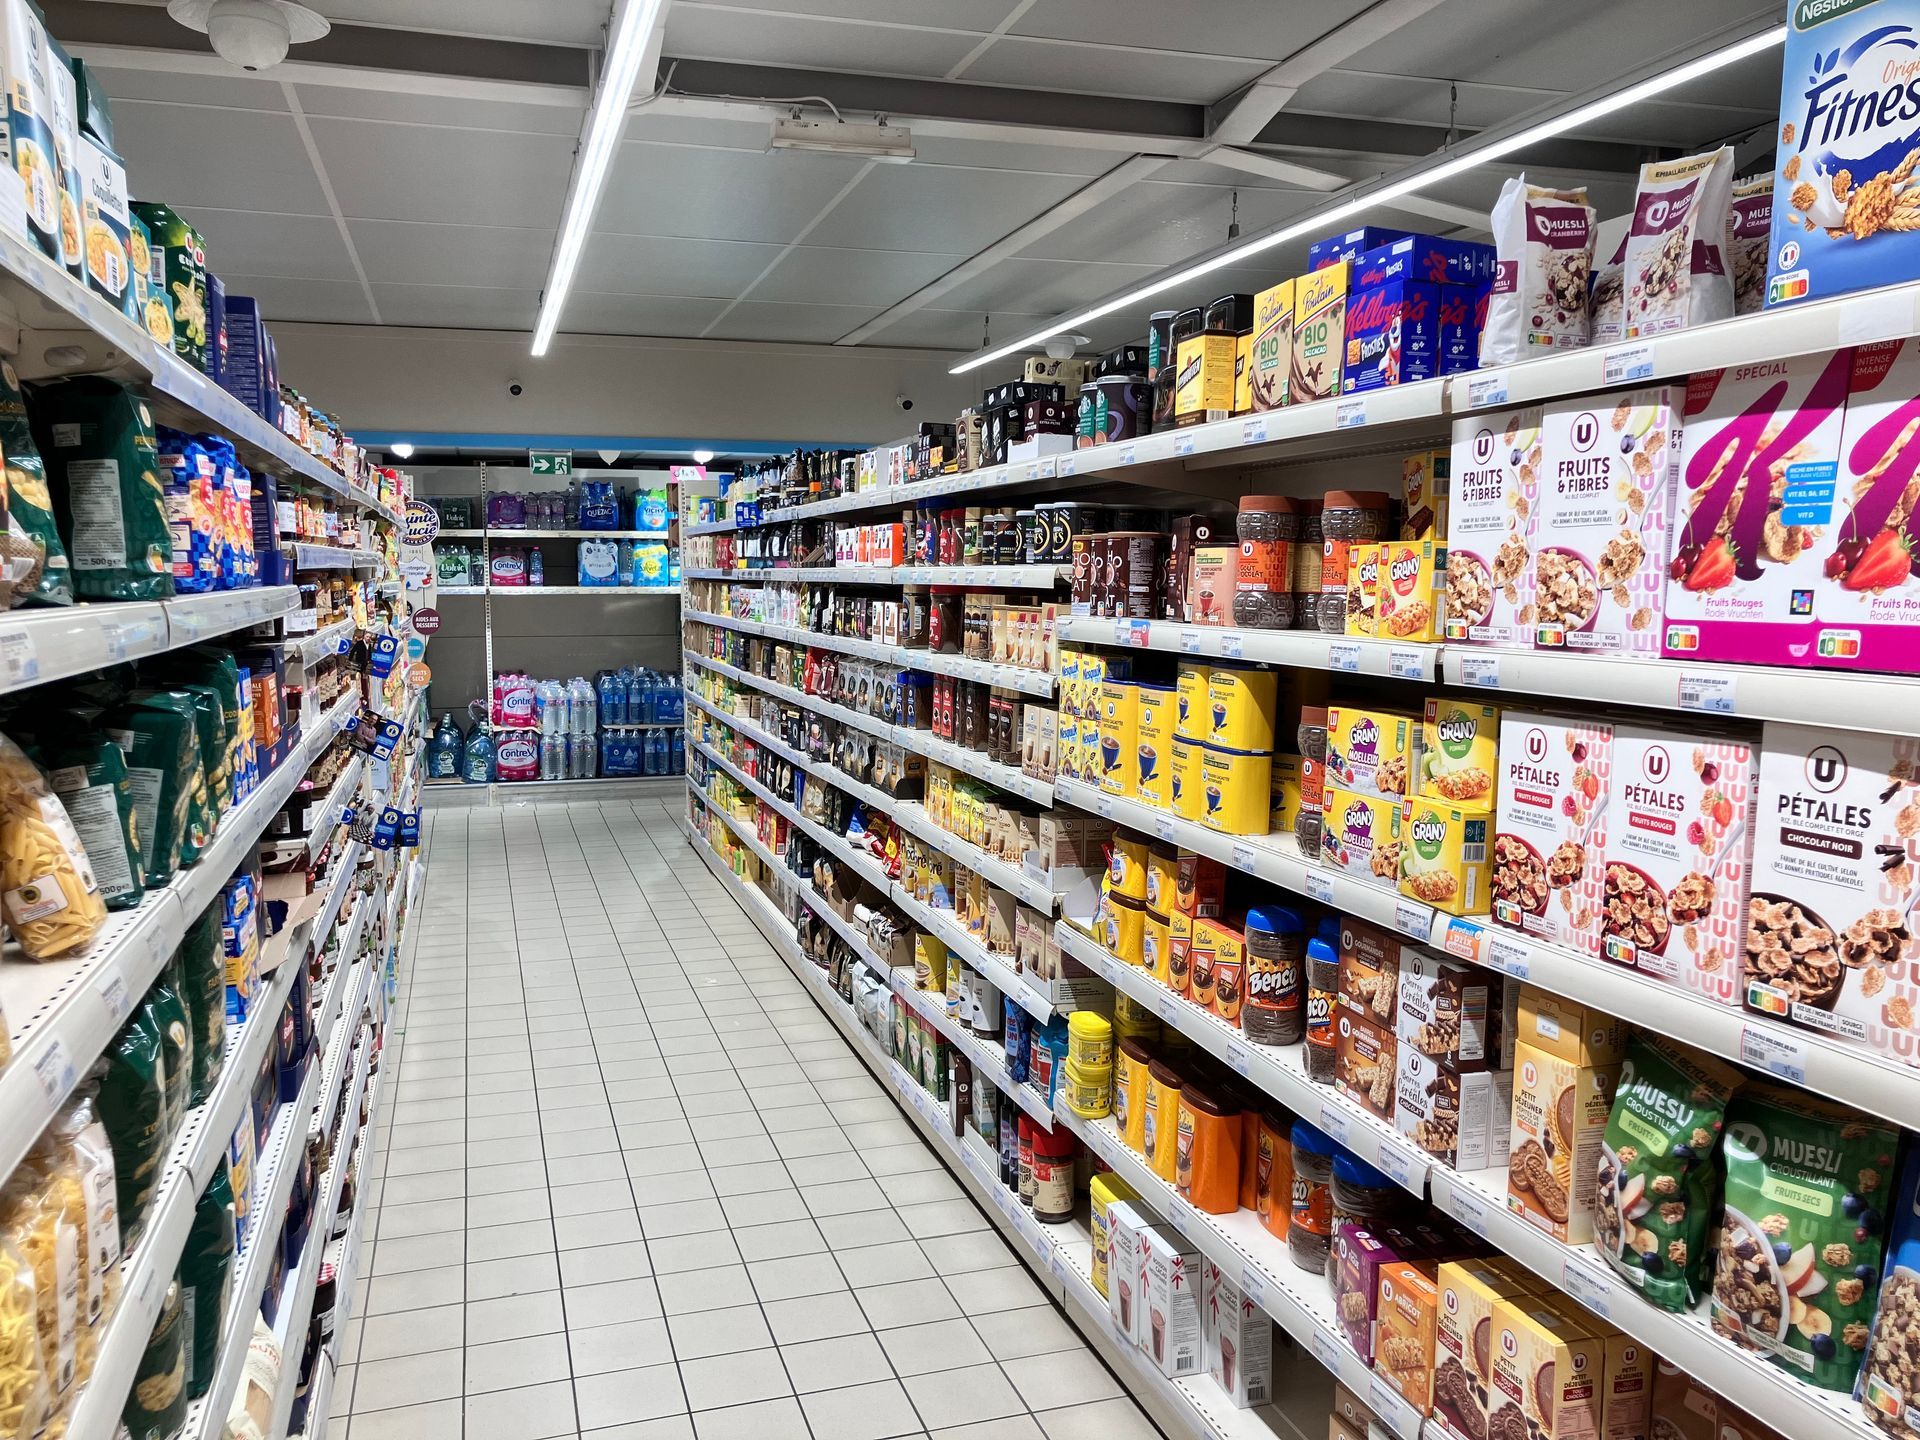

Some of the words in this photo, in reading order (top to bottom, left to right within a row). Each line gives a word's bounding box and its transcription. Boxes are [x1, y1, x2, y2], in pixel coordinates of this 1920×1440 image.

[1550, 219, 1585, 231] MUESLI
[1303, 283, 1334, 314] Poulain
[1305, 322, 1328, 345] BIO
[1260, 336, 1279, 360] BIO
[1361, 333, 1386, 361] FROSTIES
[1856, 354, 1891, 366] INTENSE
[1735, 362, 1788, 381] SPECIAL
[1855, 364, 1887, 376] SMAAK!
[1577, 423, 1591, 444] U
[1558, 457, 1611, 478] FRUITS
[1463, 468, 1503, 487] FRUITS
[1558, 481, 1565, 493] &
[1568, 476, 1609, 492] FIBRES
[1463, 492, 1468, 501] &
[1471, 486, 1501, 501] FIBRES
[441, 563, 464, 572] Volvic
[494, 561, 523, 571] Contrex
[1390, 555, 1420, 581] GRANY
[1706, 598, 1729, 608] Fruits
[1732, 598, 1763, 609] Rouges
[1872, 599, 1901, 609] Fruits
[1705, 609, 1725, 618] Rode
[1727, 609, 1763, 619] Vruchten
[1870, 611, 1896, 621] Rode
[1329, 712, 1338, 726] LU
[1427, 703, 1435, 717] LU
[1349, 725, 1379, 745] GRANY
[1437, 719, 1477, 743] GRANY
[500, 747, 535, 761] Contrex
[1347, 750, 1379, 767] MOELLEUX
[1510, 762, 1560, 787] PÉTALES
[1648, 756, 1663, 775] U
[1814, 758, 1837, 783] U
[1325, 793, 1333, 806] LU
[1516, 791, 1531, 802] FRUITS
[1532, 795, 1550, 805] ROUGES
[1624, 783, 1685, 812] PÉTALES
[1344, 808, 1374, 828] GRANY
[1403, 802, 1411, 816] LU
[1778, 791, 1872, 829] PÉTALES
[1411, 820, 1446, 843] GRANY
[1631, 814, 1650, 826] FRUITS
[1651, 818, 1673, 831] ROUGES
[1793, 817, 1803, 827] BLÉ
[1805, 821, 1834, 833] COMPLET
[1836, 826, 1844, 834] ET
[1845, 827, 1864, 838] ORGE
[1342, 832, 1373, 850] MOELLEUX
[1787, 833, 1831, 849] CHOCOLAT
[1832, 840, 1854, 853] NOIR
[1451, 923, 1475, 938] produit
[1454, 933, 1472, 947] prix
[1355, 939, 1384, 958] GOURMANDES
[1250, 967, 1298, 995] Benco
[1401, 983, 1430, 1012] Céréales
[1404, 1004, 1425, 1021] CHOCOLAT
[1842, 1019, 1863, 1030] SOURCE
[1848, 1028, 1865, 1039] FIBRES
[1352, 1028, 1381, 1049] GOURMANDES
[1398, 1080, 1428, 1109] Céréales
[1521, 1089, 1537, 1103] PETIT
[1632, 1076, 1694, 1127] MUESLI
[1399, 1100, 1423, 1118] CHOCOLAT
[1514, 1093, 1543, 1116] DÉJEUNER
[1628, 1119, 1652, 1140] FRUITS
[1772, 1136, 1844, 1174] MUESLI
[1769, 1162, 1837, 1189] CROUSTILLANT
[1774, 1185, 1801, 1202] FRUITS
[1802, 1192, 1821, 1207] SECS
[1395, 1293, 1422, 1320] ABRICOT
[1438, 1317, 1463, 1341] DÉJEUNER
[1443, 1313, 1457, 1328] PETIT
[1438, 1335, 1461, 1356] CHOCOLAT
[1500, 1355, 1516, 1371] PETIT
[1494, 1359, 1523, 1387] DÉJEUNER
[1500, 1375, 1514, 1389] TOUT
[1494, 1378, 1521, 1402] CHOCOLAT
[1564, 1379, 1593, 1389] DÉJEUNER
